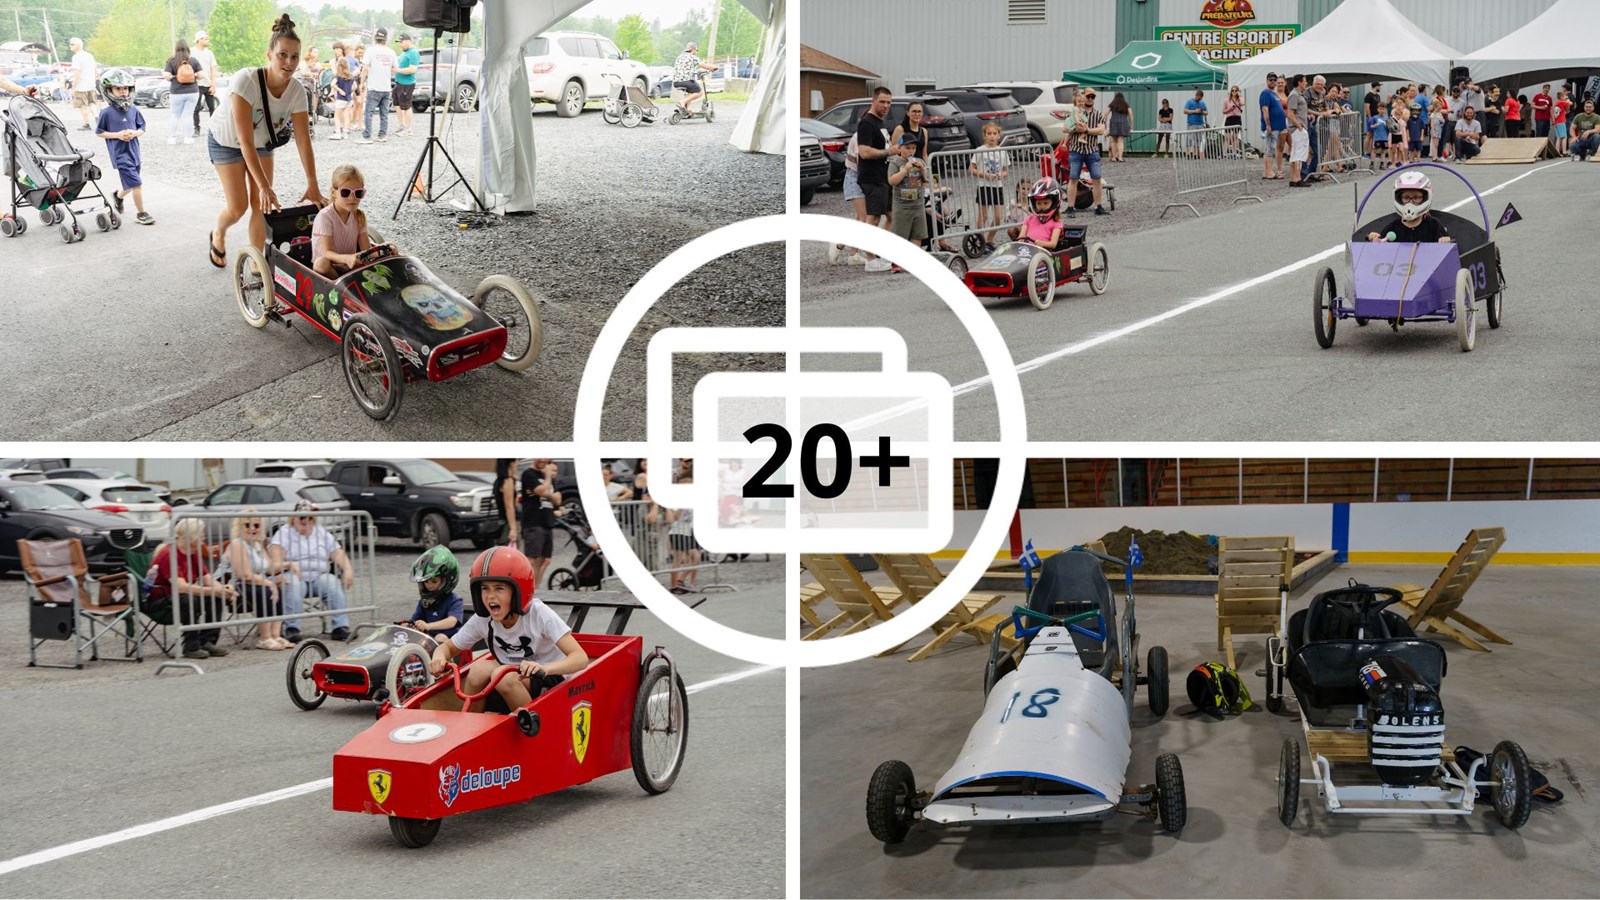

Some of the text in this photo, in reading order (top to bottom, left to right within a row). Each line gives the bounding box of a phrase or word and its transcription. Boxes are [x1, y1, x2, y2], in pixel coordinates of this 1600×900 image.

[1163, 31, 1293, 45] CENTRE SPORTIF
[1194, 48, 1250, 60] ACINE
[1126, 76, 1158, 84] Desjardins
[1502, 208, 1514, 225] 3
[1372, 262, 1418, 277] 03
[296, 271, 313, 311] 29
[1000, 687, 1062, 724] 18
[406, 727, 426, 737] 1
[460, 764, 521, 793] deloupe
